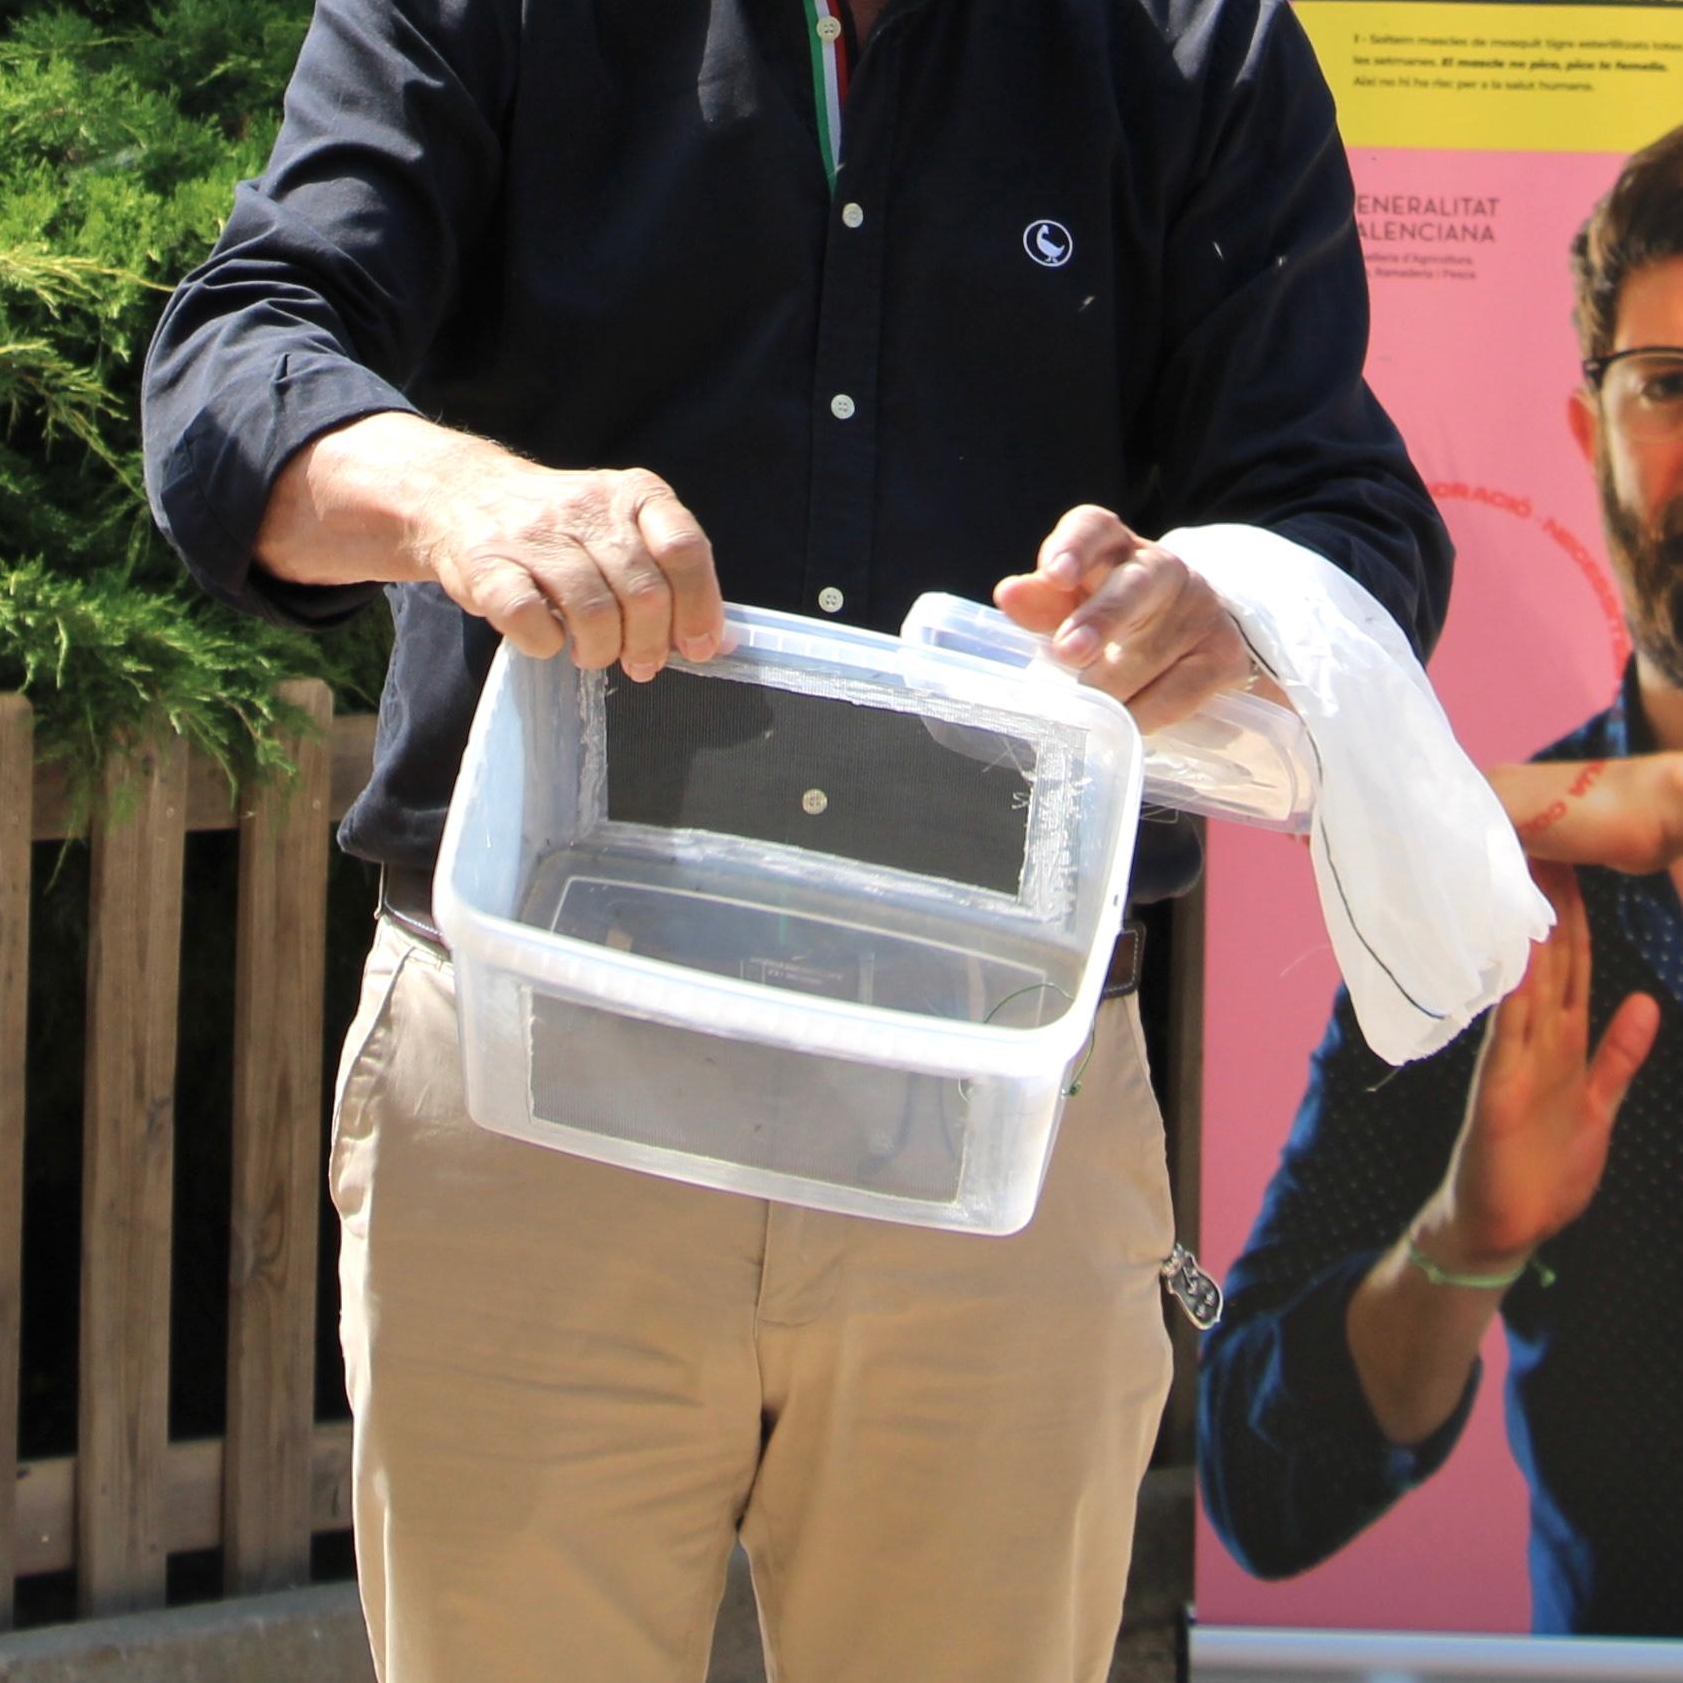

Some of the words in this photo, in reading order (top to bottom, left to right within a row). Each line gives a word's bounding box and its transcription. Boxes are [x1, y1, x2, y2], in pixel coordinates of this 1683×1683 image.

[1471, 35, 1486, 47] de
[1356, 196, 1501, 216] ENERALITAT
[1357, 221, 1496, 242] ALENCIANA
[1429, 482, 1533, 518] ORACIÓ
